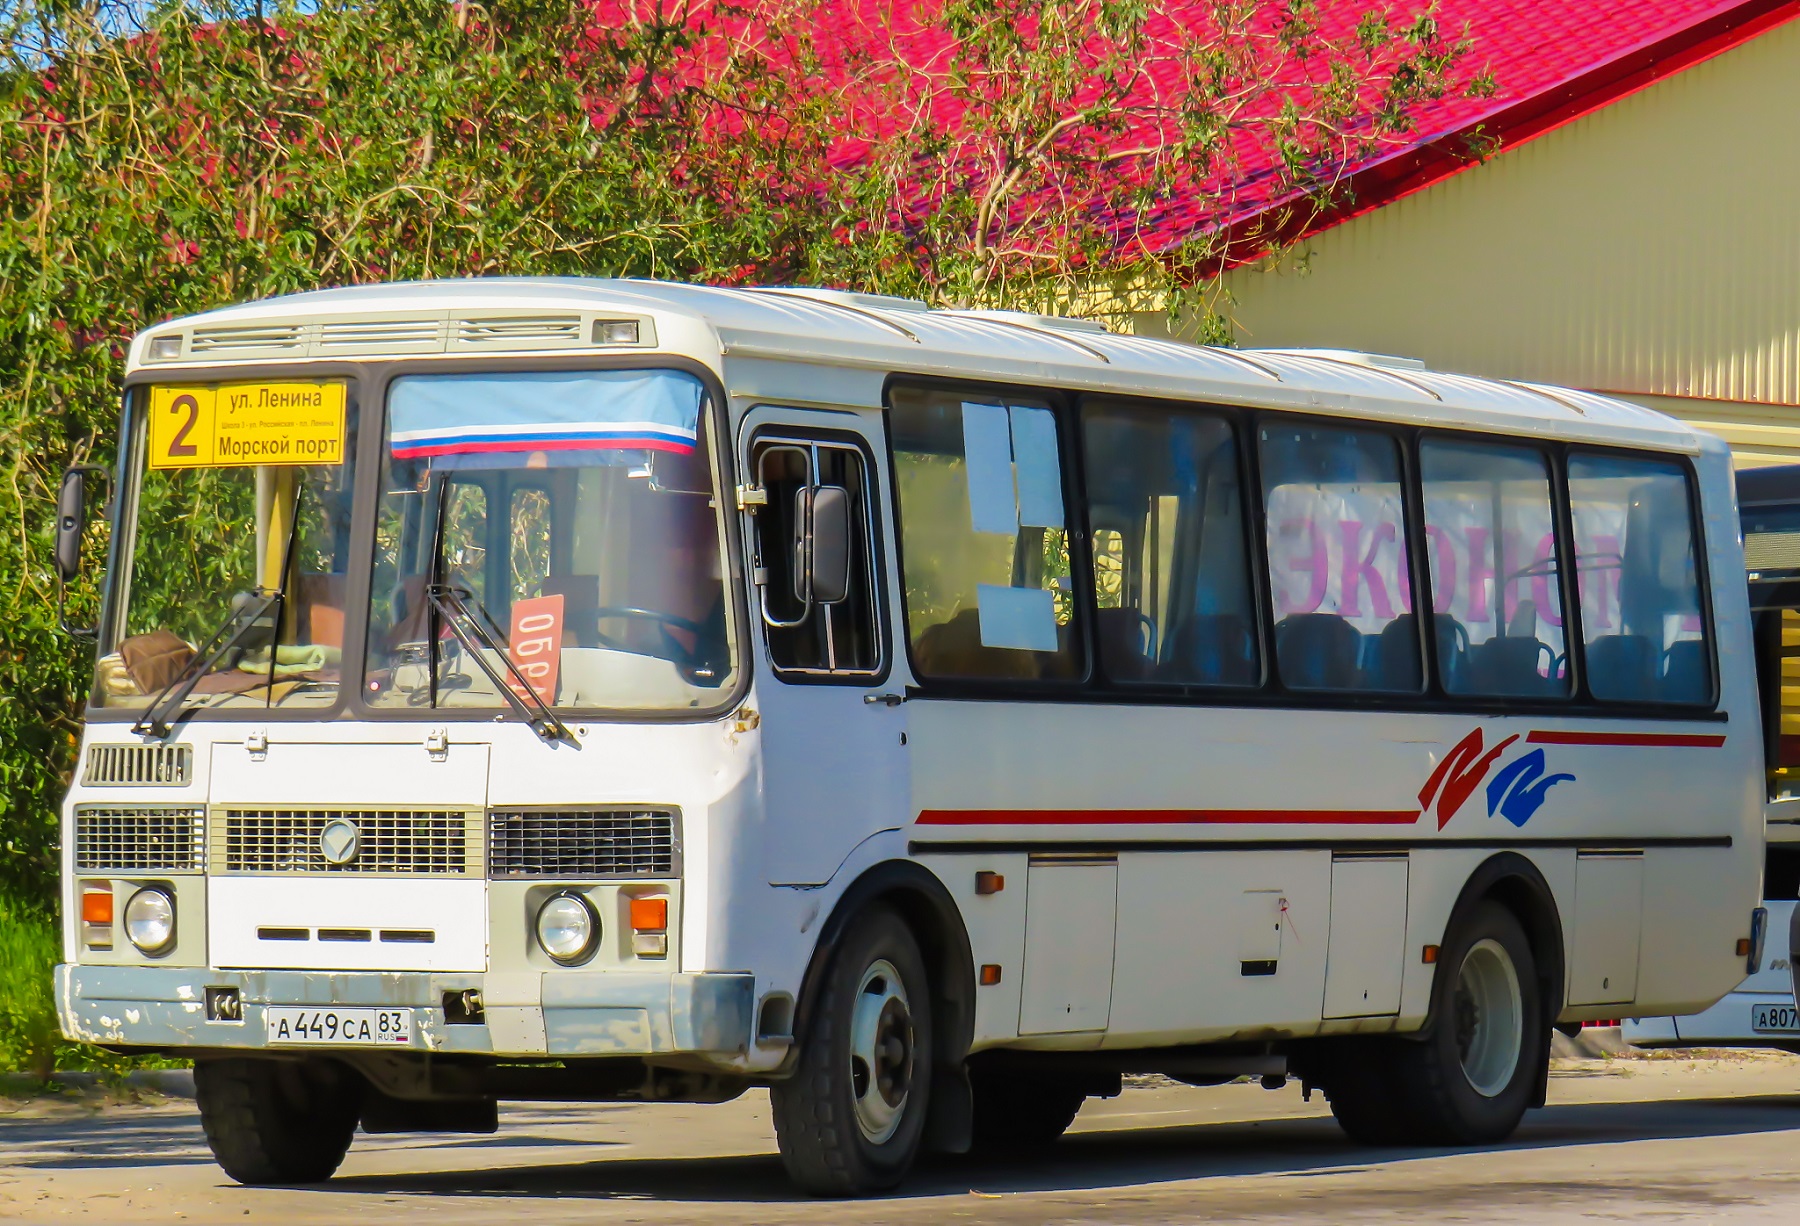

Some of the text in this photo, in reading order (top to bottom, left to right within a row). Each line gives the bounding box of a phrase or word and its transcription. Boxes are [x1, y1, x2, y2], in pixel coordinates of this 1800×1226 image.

[230, 388, 322, 414] ул. Ленина
[167, 394, 199, 457] 2
[219, 434, 337, 460] Морской порт
[379, 1013, 402, 1033] 83
[378, 1033, 395, 1041] RUS
